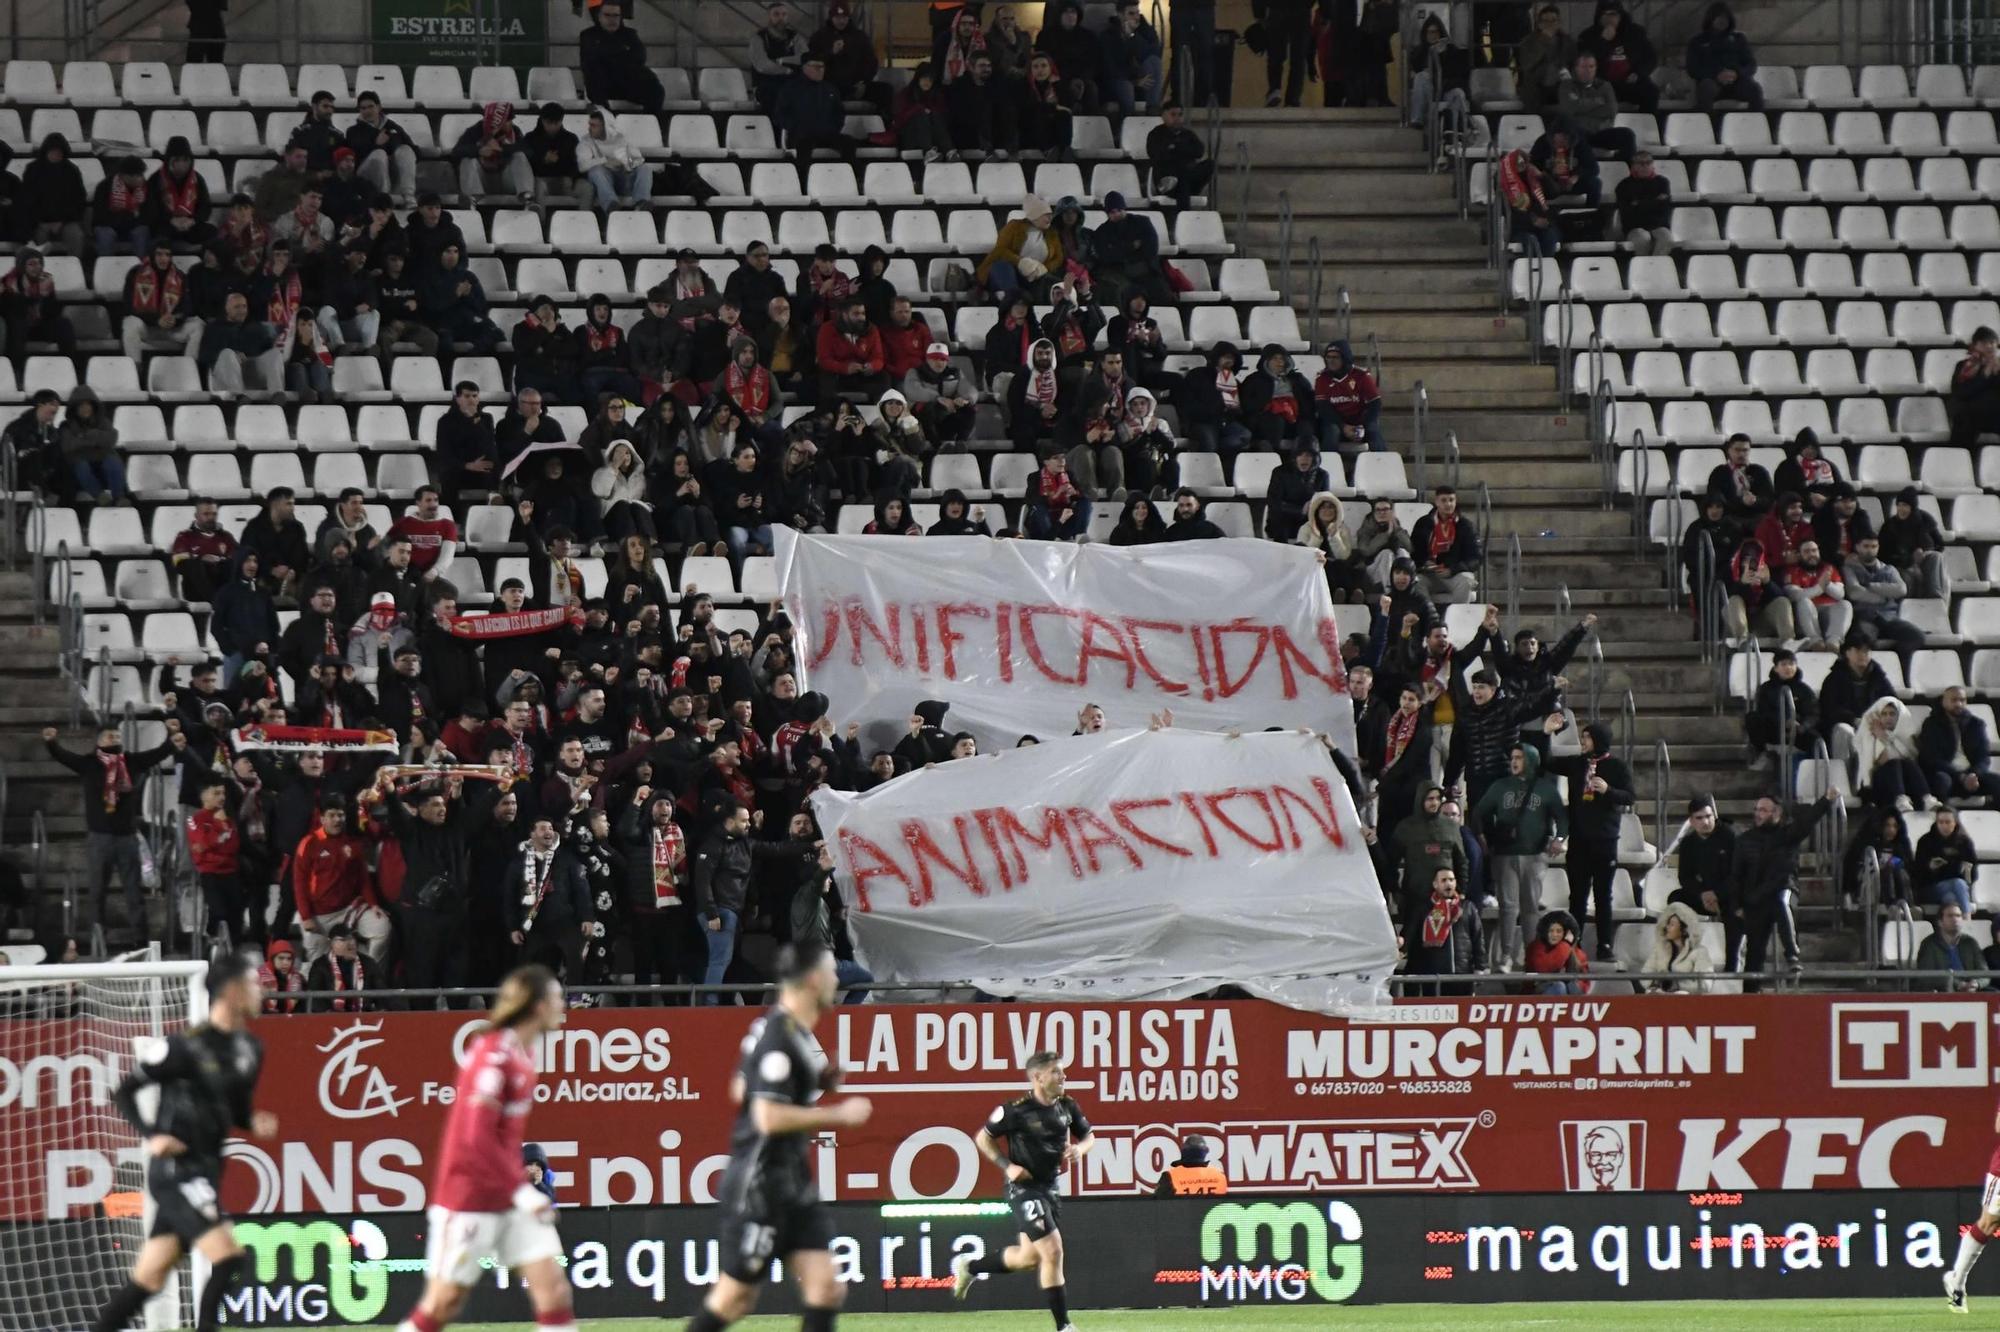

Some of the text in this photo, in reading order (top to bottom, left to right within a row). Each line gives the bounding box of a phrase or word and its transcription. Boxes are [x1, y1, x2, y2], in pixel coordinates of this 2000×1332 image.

[391, 17, 526, 35] ESTRELLA
[1468, 1003, 1512, 1024] DTI
[1516, 1003, 1568, 1023] DTF
[1571, 1002, 1610, 1022] UV
[838, 1008, 1239, 1072] LA POLVORISTA
[1286, 1026, 1757, 1079] MURCIAPRINT
[1100, 1069, 1239, 1102] LACADOS
[1311, 1082, 1385, 1096] 667837020
[1399, 1080, 1473, 1095] 968535828
[1676, 1116, 1947, 1191] KFC
[1021, 1199, 1046, 1221] 21
[1467, 1208, 1945, 1287] maquinaria
[1200, 1264, 1308, 1301] MMG
